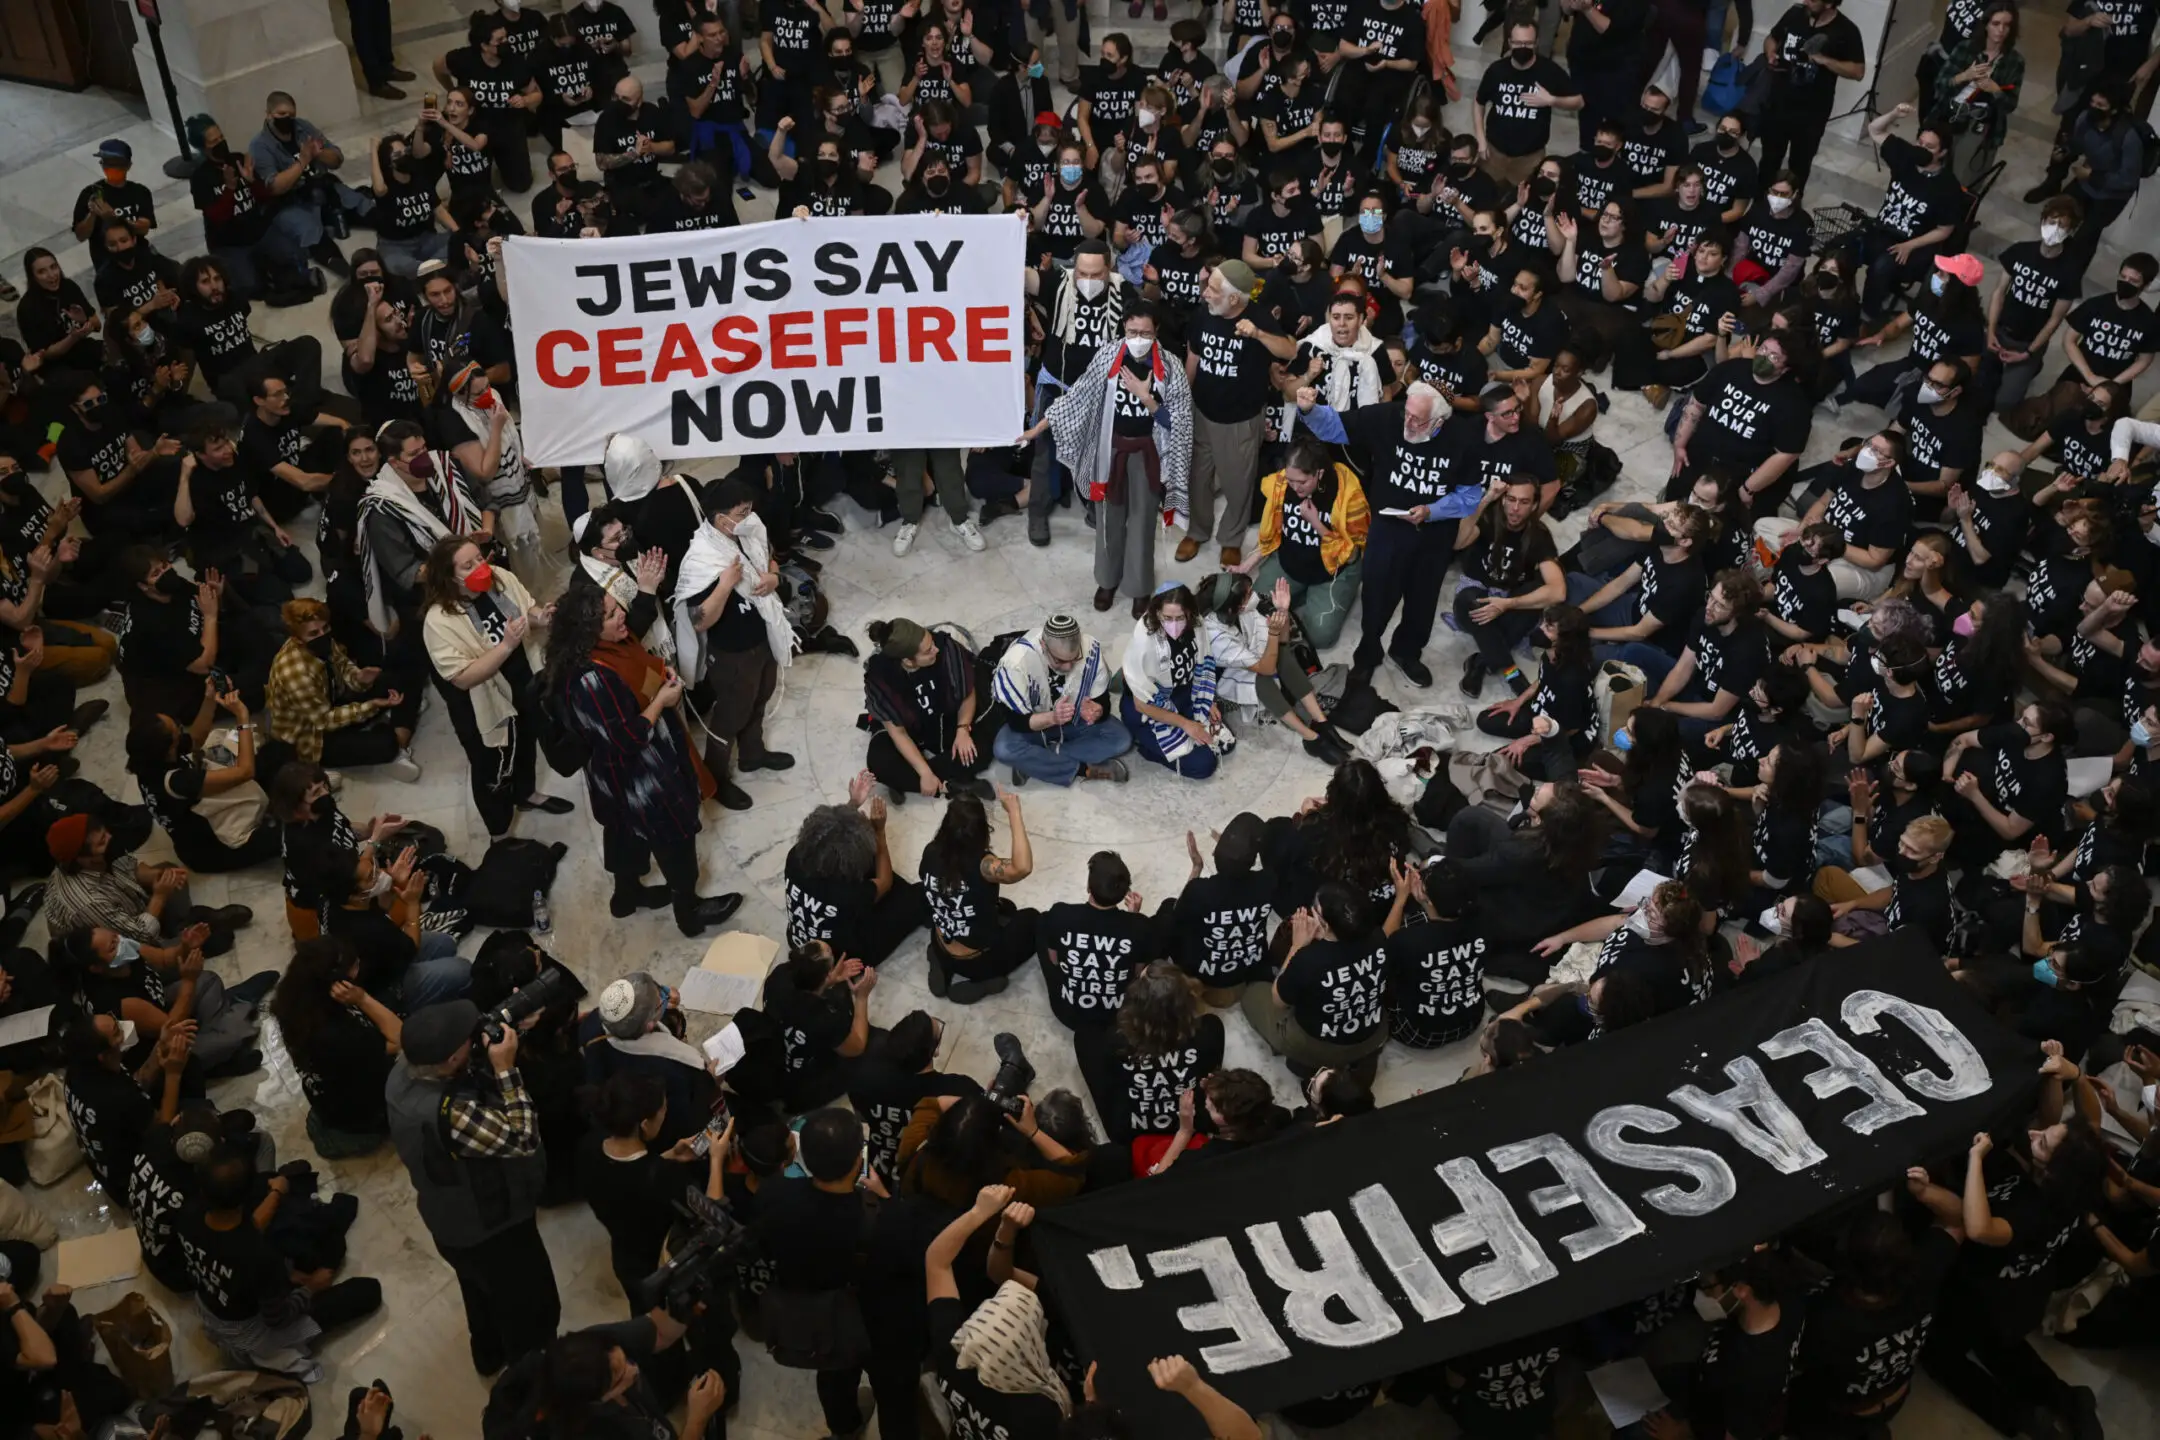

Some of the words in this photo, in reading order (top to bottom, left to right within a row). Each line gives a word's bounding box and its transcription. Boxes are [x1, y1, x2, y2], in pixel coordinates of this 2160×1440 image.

[2127, 2, 2143, 13] IN
[798, 19, 810, 29] IN
[1363, 17, 1389, 31] NOT
[1390, 24, 1404, 36] IN
[2111, 14, 2134, 25] UR
[526, 29, 540, 41] IN
[776, 26, 803, 40] OUR
[1366, 29, 1395, 44] OUR
[1358, 39, 1398, 59] NME
[548, 64, 572, 77] NOT
[575, 61, 589, 72] IN
[470, 79, 494, 90] NOT
[501, 80, 515, 90] IN
[558, 72, 587, 86] OUR
[1498, 83, 1524, 94] NOT
[474, 90, 510, 102] OUR
[920, 88, 949, 99] OUR
[1096, 91, 1117, 101] NOT
[1120, 90, 1136, 100] IN
[1099, 100, 1130, 111] OUR
[951, 145, 964, 154] IN
[1624, 141, 1650, 155] NOT
[1652, 147, 1667, 158] IN
[1628, 152, 1660, 166] OUR
[1602, 182, 1614, 192] IN
[1706, 180, 1727, 195] UR
[1723, 174, 1737, 186] IN
[402, 203, 432, 217] OUR
[676, 219, 698, 230] NOT
[703, 214, 719, 225] IN
[1132, 215, 1156, 225] NOT
[1262, 232, 1288, 243] NOT
[1292, 230, 1305, 241] IN
[1749, 226, 1774, 243] NOT
[1778, 237, 1793, 248] IN
[1752, 241, 1782, 257] OUR
[575, 248, 792, 317] JEWS
[813, 240, 964, 296] SAY
[1161, 268, 1190, 281] NOT
[2012, 261, 2039, 282] NOT
[2043, 275, 2059, 290] IN
[1165, 280, 1200, 295] OUR
[2014, 276, 2047, 298] OUR
[230, 311, 245, 323] IN
[1914, 310, 1935, 331] NOT
[1936, 330, 1951, 345] IN
[2090, 317, 2118, 334] NOT
[2127, 327, 2144, 342] IN
[536, 306, 1012, 388] CEASEFIRE
[1201, 331, 1226, 349] NOT
[1229, 338, 1243, 351] IN
[1913, 324, 1940, 351] OUR
[2092, 330, 2130, 350] OUR
[1420, 359, 1448, 378] NOT
[1451, 371, 1464, 384] IN
[1723, 382, 1751, 405] NOT
[1755, 399, 1771, 414] IN
[671, 376, 884, 446] NOW!
[1721, 398, 1757, 422] OUR
[1708, 406, 1756, 440] NAME
[1910, 416, 1930, 439] NOT
[1930, 434, 1943, 451] IN
[1396, 444, 1426, 468] NOT
[1432, 455, 1450, 470] IN
[2088, 450, 2103, 467] IN
[1401, 461, 1440, 483] OUR
[1389, 470, 1448, 498] NAME
[1204, 903, 1271, 925] JEWS
[1212, 920, 1261, 940] SAY
[1060, 931, 1133, 954] JEWS
[1067, 949, 1121, 970] SAY
[1420, 938, 1486, 969] JEWS
[1059, 962, 1128, 982] CEASE
[1321, 947, 1387, 988] JEWS
[1430, 957, 1479, 983] SAY
[1068, 979, 1117, 995] FIRE
[1332, 968, 1382, 1001] SAY
[1061, 989, 1125, 1010] NOW
[1429, 986, 1476, 1005] FIRE
[1333, 999, 1378, 1023] FIRE
[1320, 1005, 1382, 1037] NOW
[1133, 1067, 1193, 1089] SAY
[1139, 1100, 1179, 1115] FIR
[1130, 1112, 1174, 1131] NO
